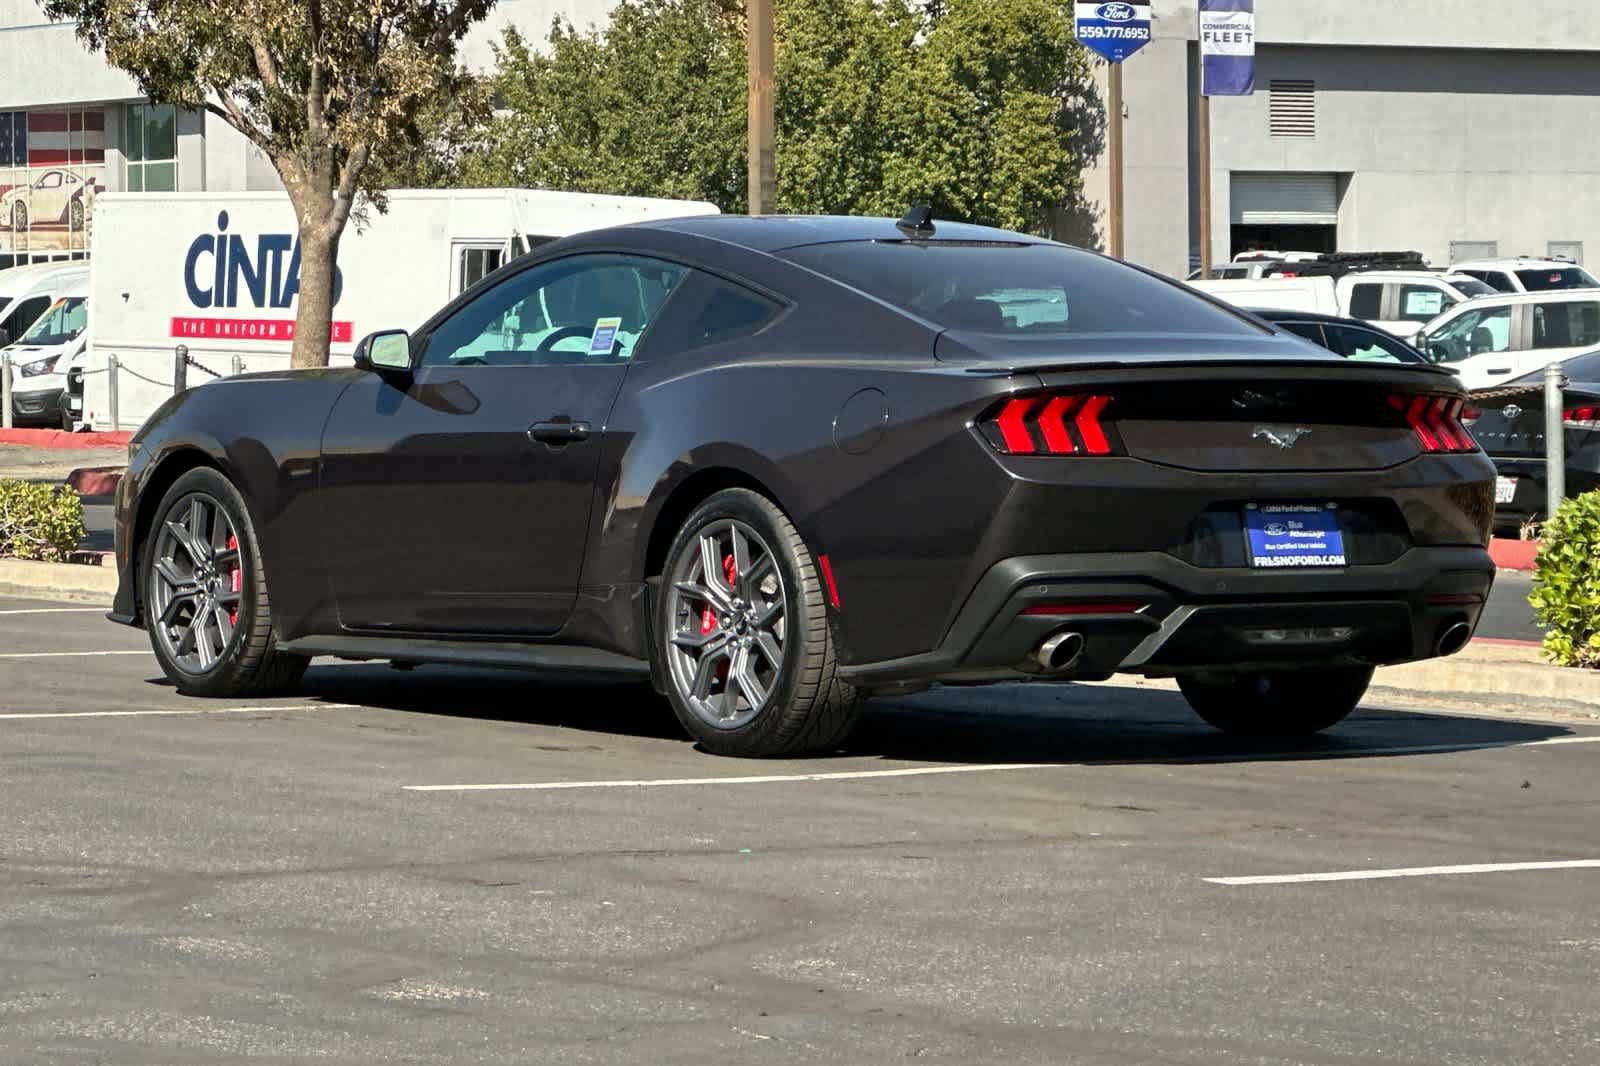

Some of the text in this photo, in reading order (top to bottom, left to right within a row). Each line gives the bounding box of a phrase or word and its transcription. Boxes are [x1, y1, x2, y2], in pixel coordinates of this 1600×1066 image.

[1103, 4, 1131, 19] Ford
[1079, 26, 1149, 39] 559.777.6952
[1203, 31, 1253, 43] FLEET
[182, 321, 206, 334] THE
[215, 322, 277, 336] UNIFORM
